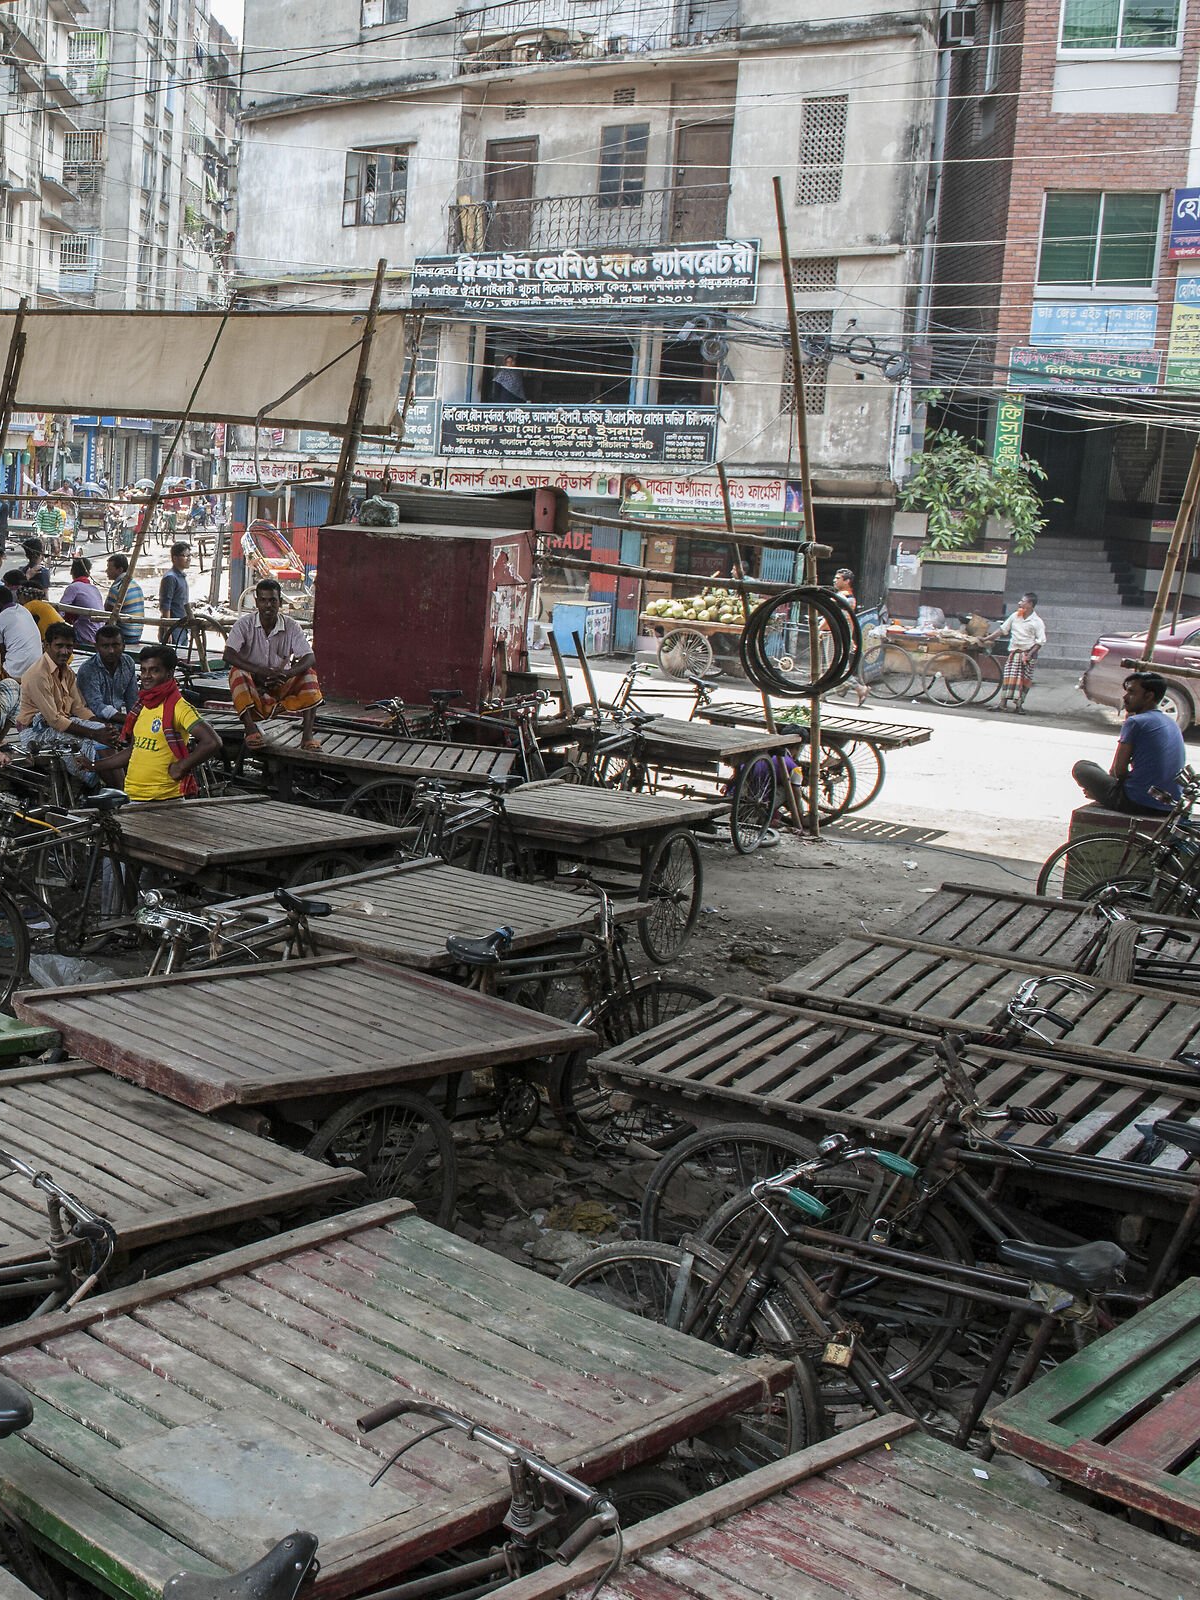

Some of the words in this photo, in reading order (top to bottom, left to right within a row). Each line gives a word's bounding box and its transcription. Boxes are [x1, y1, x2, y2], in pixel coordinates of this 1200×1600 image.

[455, 252, 533, 283] রিফাইন
[535, 250, 598, 280] হোমিও
[601, 254, 634, 280] হল
[652, 241, 755, 276] ল্যাবরেটরী
[1037, 307, 1052, 319] ডাঃ
[1107, 368, 1142, 379] কেন্দ্র
[596, 424, 645, 436] ইসলাম
[449, 468, 488, 486] মেসার্স
[555, 471, 595, 491] ট্রেডার্স
[646, 480, 672, 496] পাবনা
[749, 480, 781, 501] ফার্মেসী
